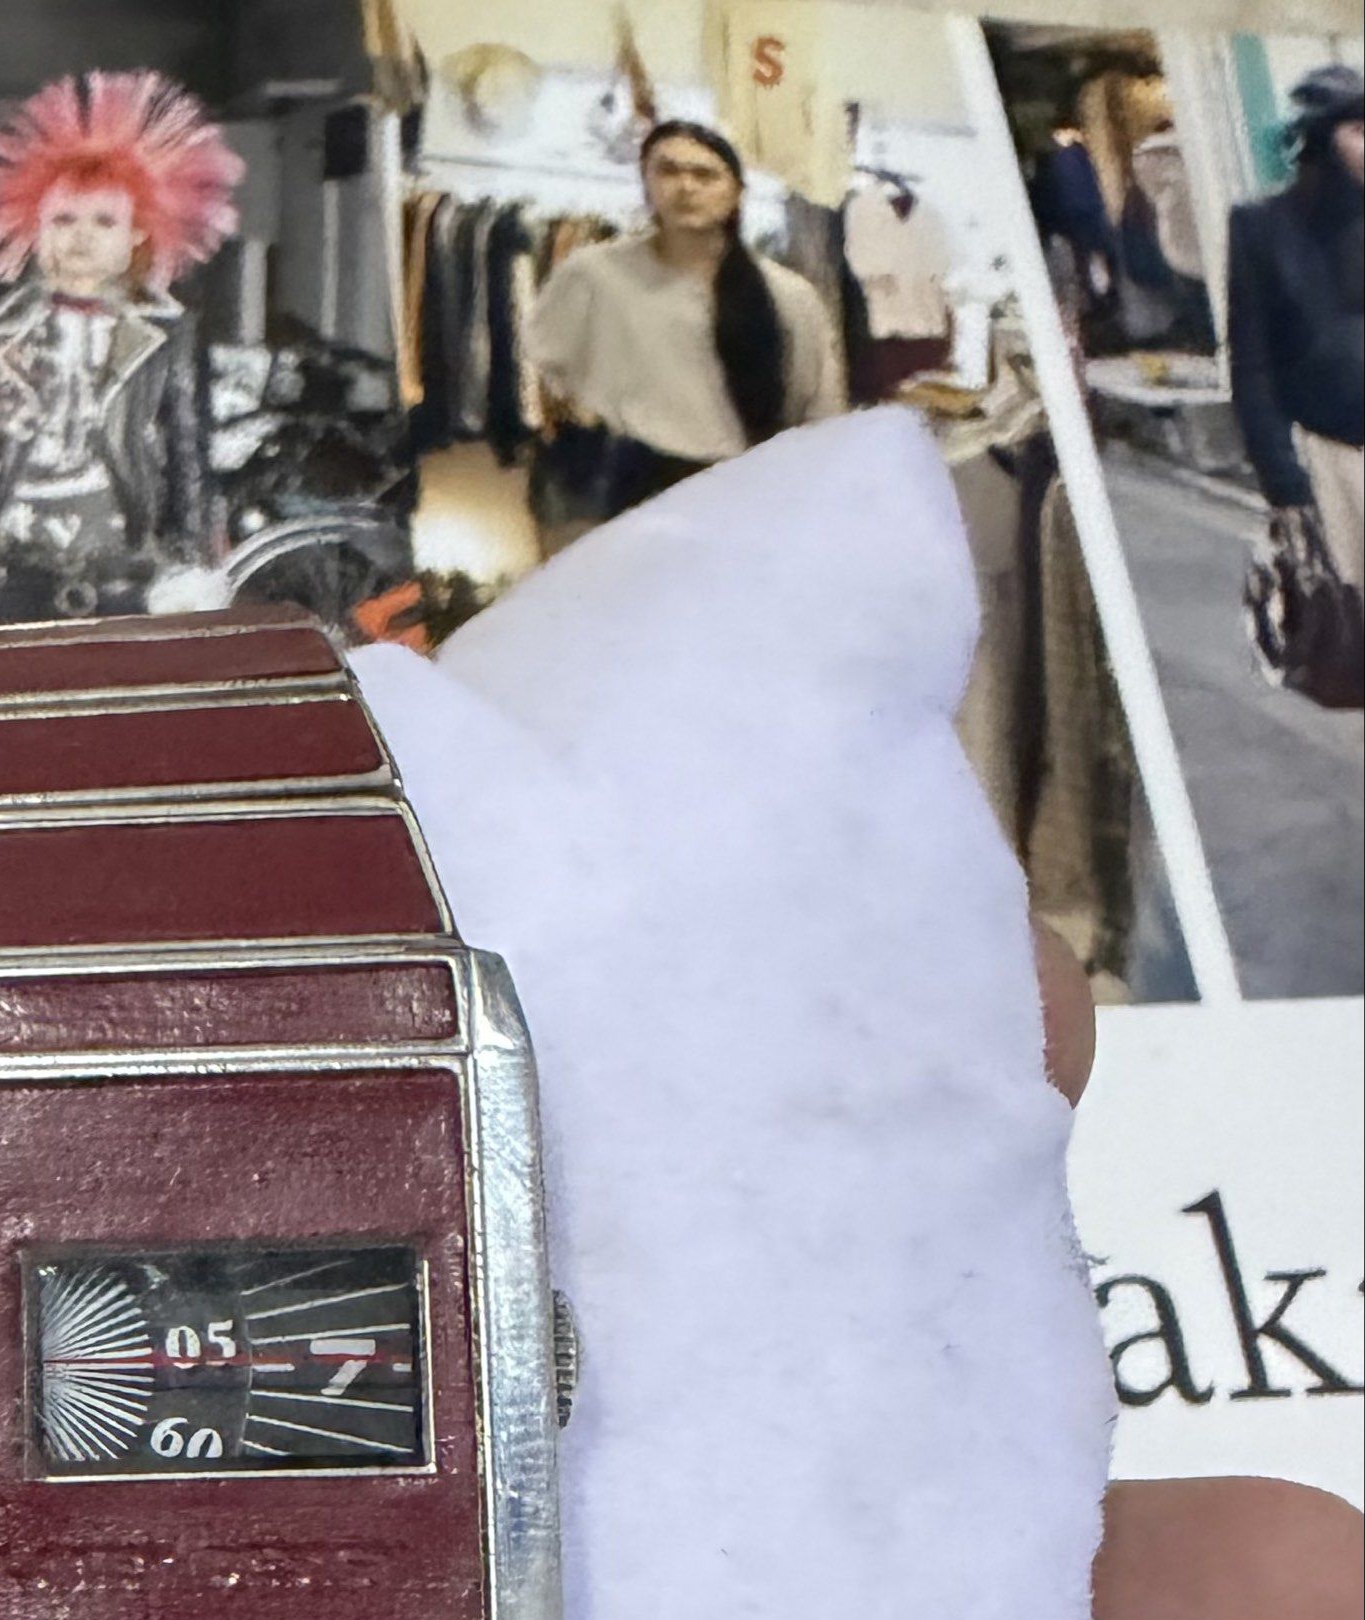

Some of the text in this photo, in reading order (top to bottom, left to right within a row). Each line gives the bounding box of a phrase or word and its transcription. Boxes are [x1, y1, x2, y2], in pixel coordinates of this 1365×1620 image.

[752, 36, 785, 88] S
[1093, 1188, 1365, 1408] ak
[165, 1319, 236, 1369] 05
[309, 1338, 376, 1396] 7
